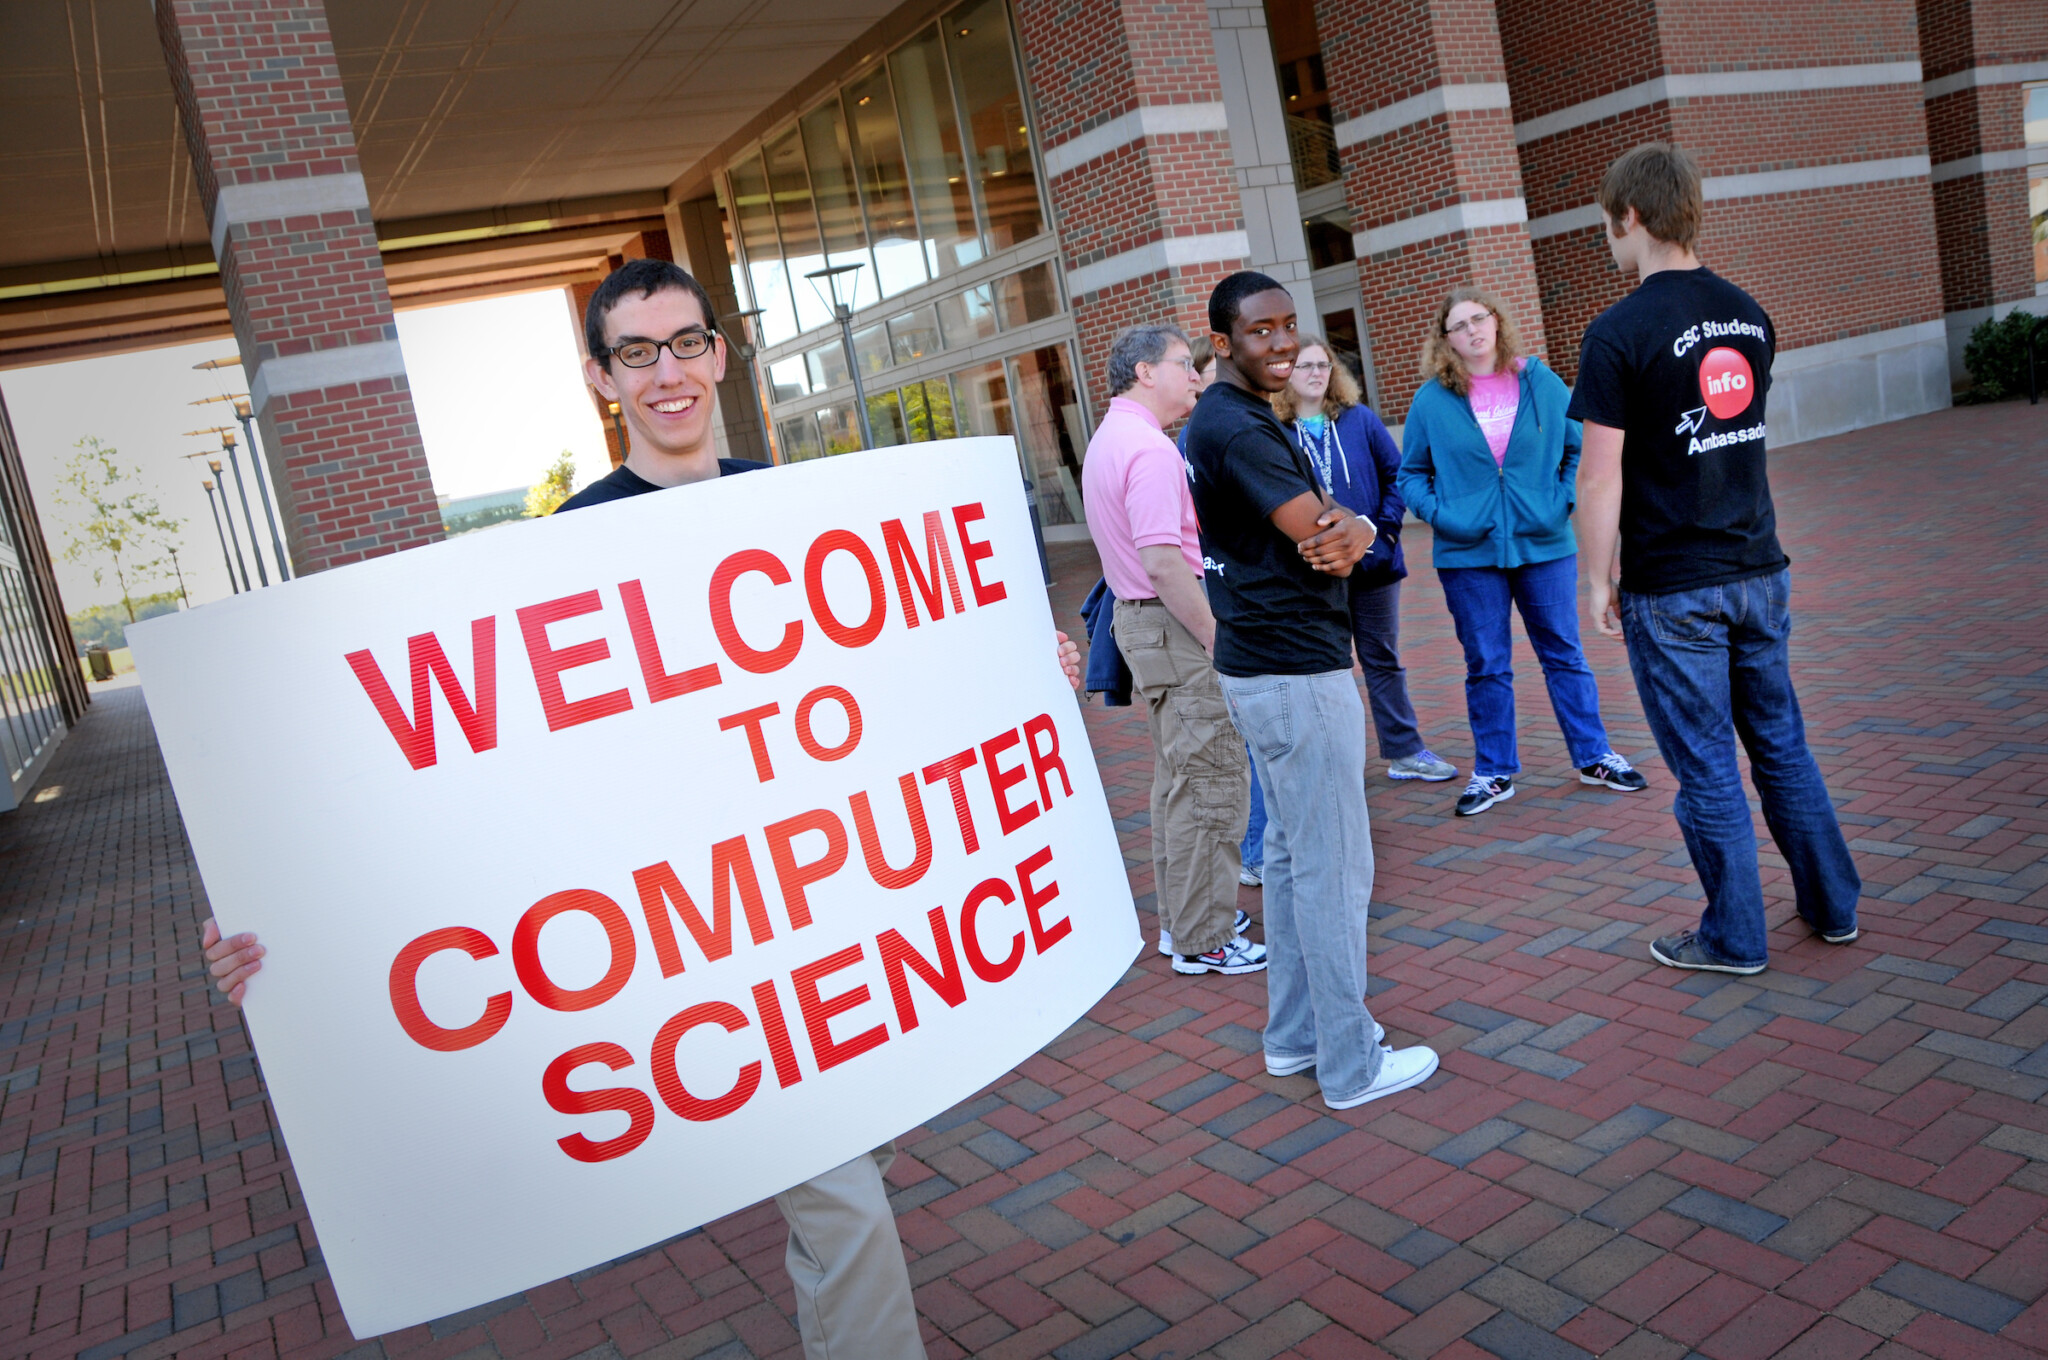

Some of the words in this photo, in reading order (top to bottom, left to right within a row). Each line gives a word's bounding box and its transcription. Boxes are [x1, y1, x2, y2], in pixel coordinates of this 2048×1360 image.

[1673, 325, 1701, 357] CSC
[1702, 318, 1766, 342] Student
[1706, 371, 1747, 395] info
[344, 501, 1008, 772] WELCOME
[717, 684, 864, 784] TO
[388, 712, 1075, 1052] COMPUTER
[541, 844, 1073, 1164] SCIENCE
